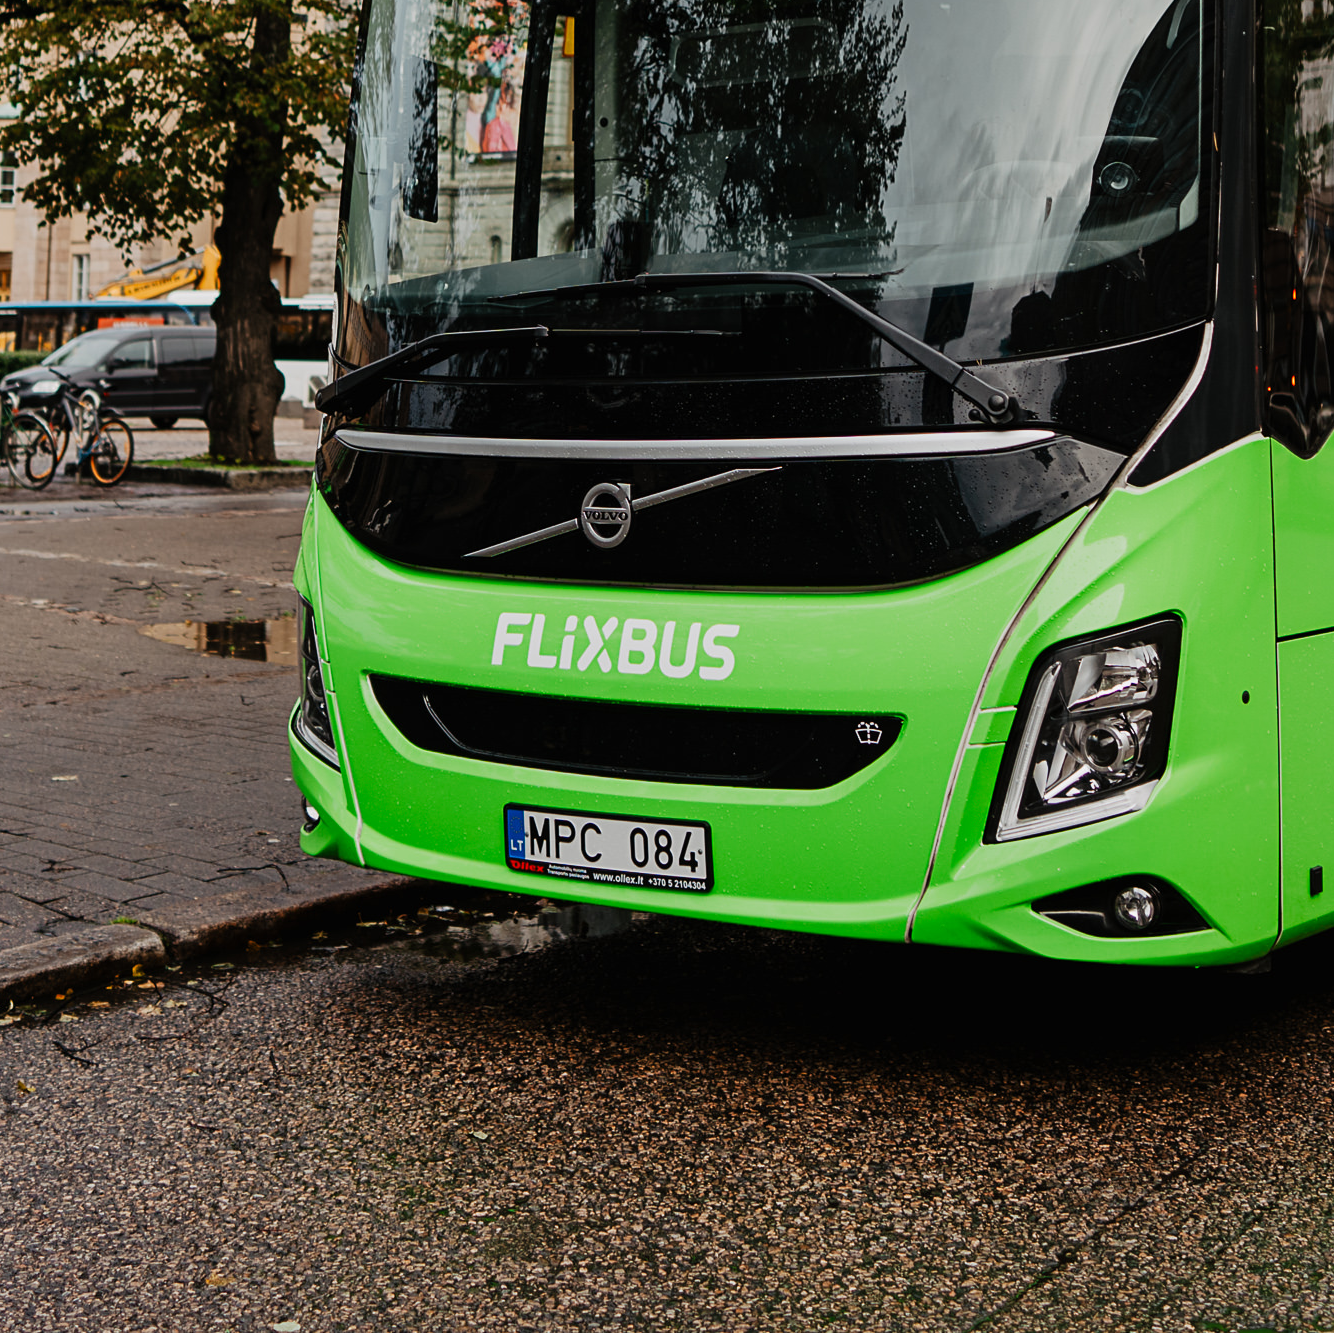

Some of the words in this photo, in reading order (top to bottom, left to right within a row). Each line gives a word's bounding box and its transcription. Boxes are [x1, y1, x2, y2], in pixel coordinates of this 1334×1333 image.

[582, 509, 629, 522] VOLVO
[510, 838, 524, 853] LT
[528, 815, 603, 863] MPC
[629, 826, 699, 874] 084
[592, 872, 644, 886] www.ollex.lt
[648, 877, 667, 887] +370
[667, 878, 673, 888] 5
[674, 879, 707, 891] 2104304
